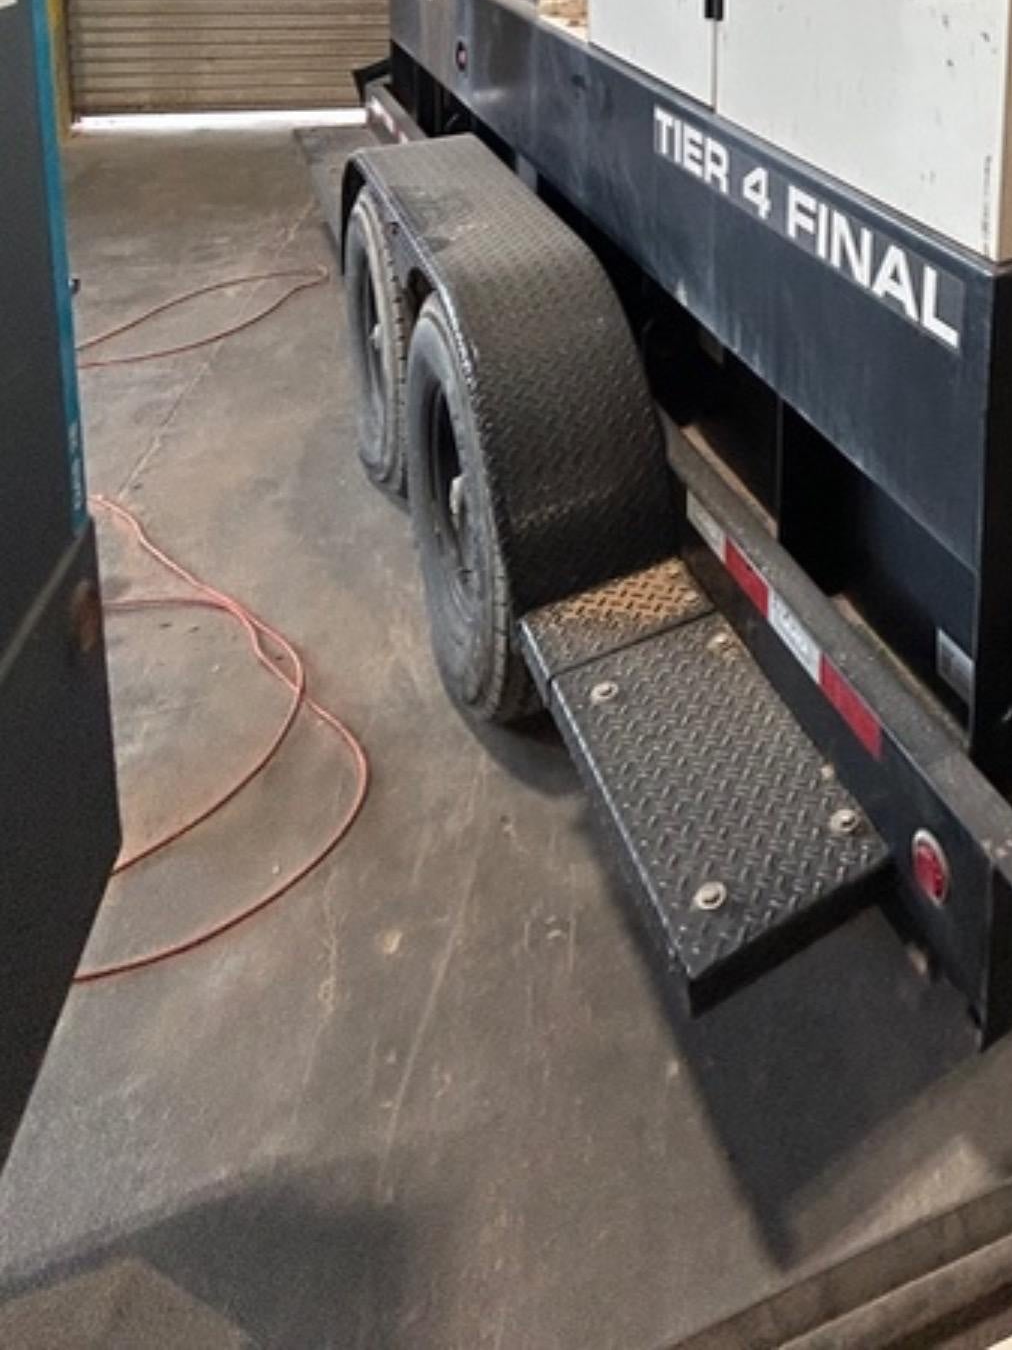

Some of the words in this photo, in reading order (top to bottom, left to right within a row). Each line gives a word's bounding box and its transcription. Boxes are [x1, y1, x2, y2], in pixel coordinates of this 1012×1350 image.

[654, 106, 730, 195] TIER
[743, 167, 771, 220] 4
[787, 185, 959, 349] FINAL
